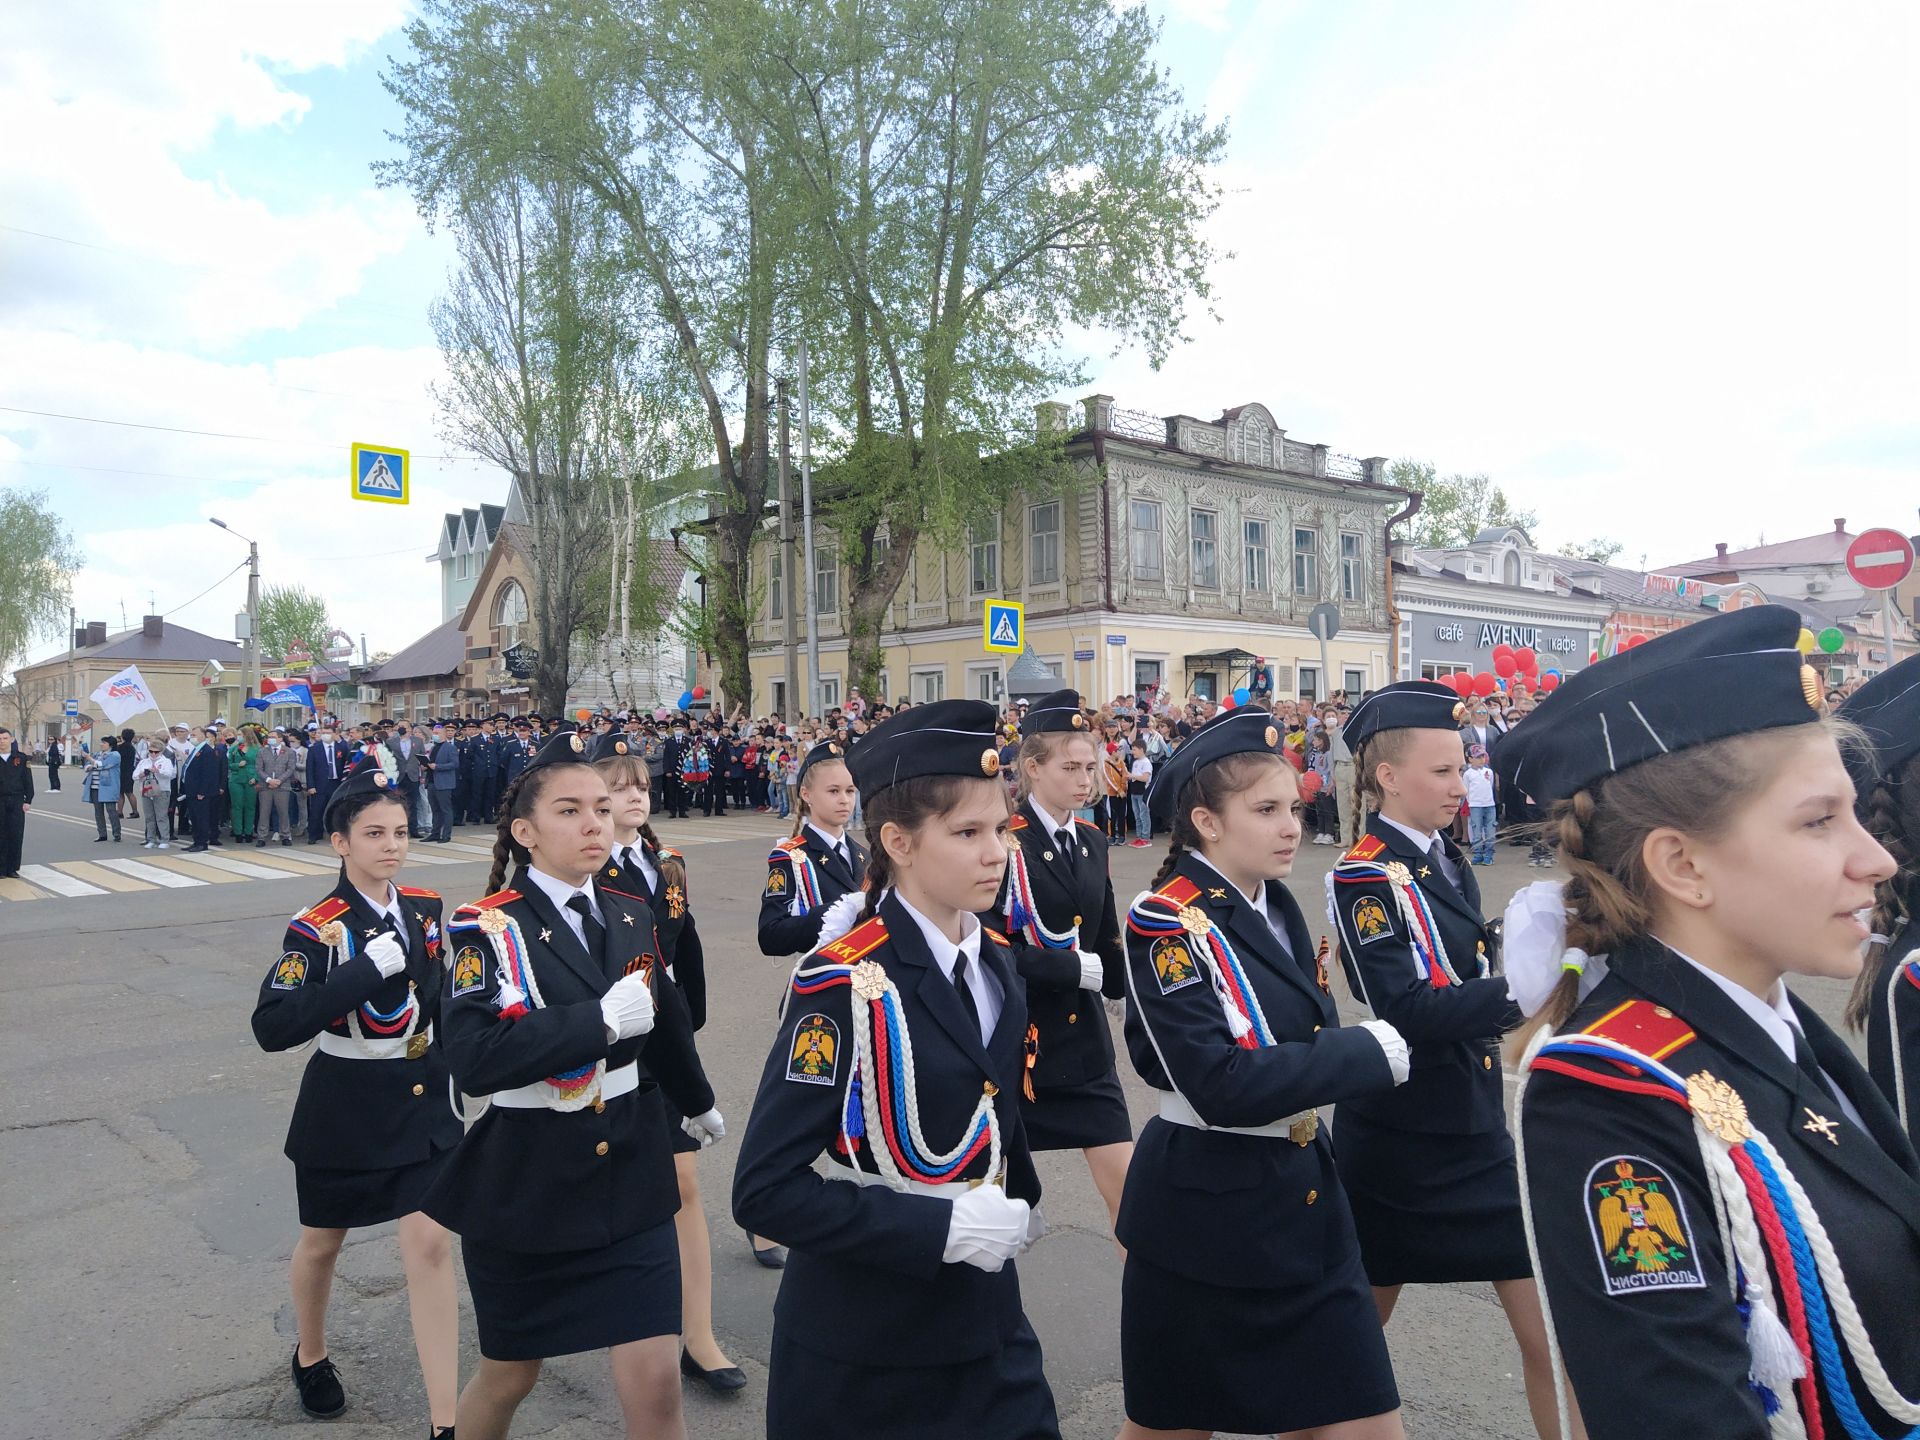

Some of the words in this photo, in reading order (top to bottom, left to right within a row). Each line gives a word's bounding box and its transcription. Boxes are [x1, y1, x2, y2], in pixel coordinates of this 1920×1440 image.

[1646, 575, 1676, 594] АПТЕКА
[1438, 622, 1464, 641] café
[1478, 622, 1543, 652] AVENUE
[1550, 635, 1577, 655] кафе
[789, 1072, 832, 1084] ЧИСТОПОЛЬ
[1610, 1270, 1699, 1289] ЧИСТОПОЛЬ
